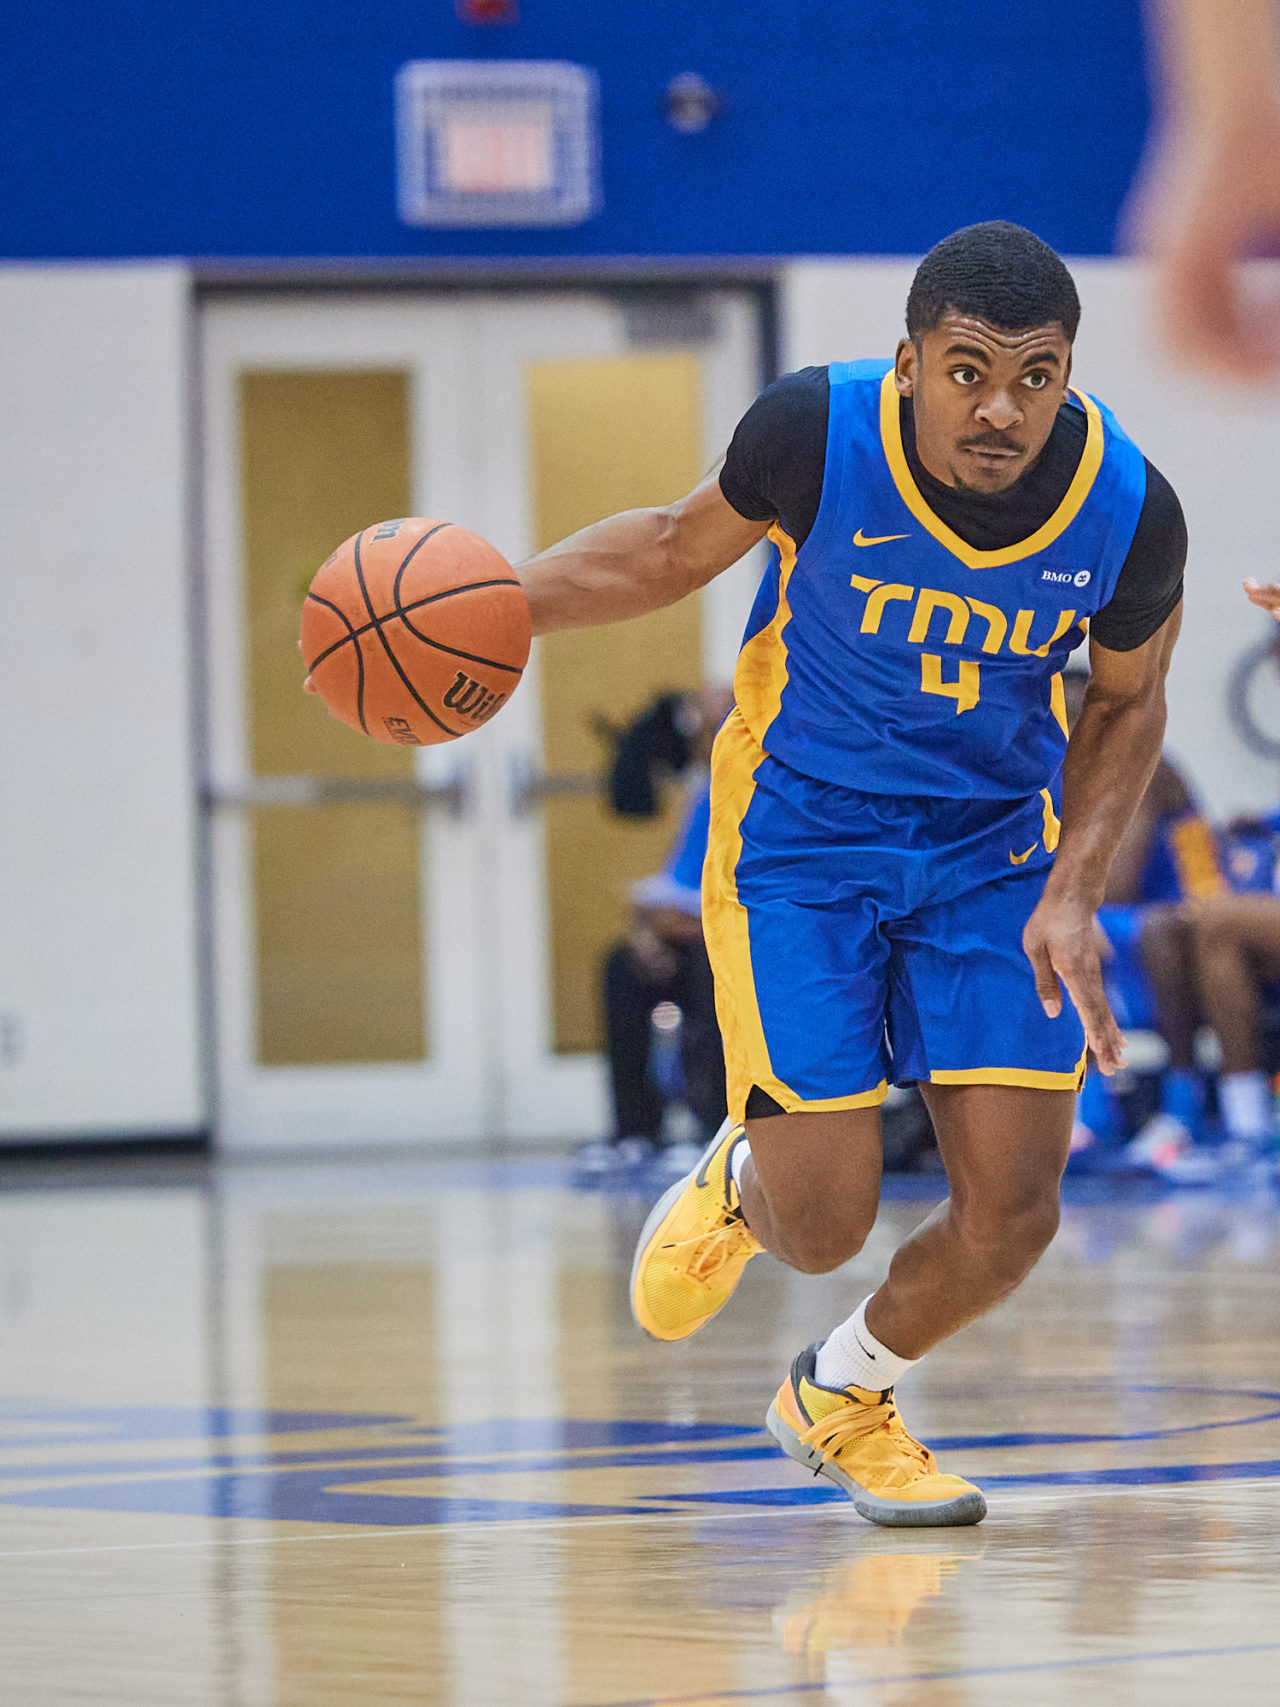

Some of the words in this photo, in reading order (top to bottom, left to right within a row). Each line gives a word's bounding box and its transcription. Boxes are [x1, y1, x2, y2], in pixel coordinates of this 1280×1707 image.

[1041, 569, 1073, 583] BMO
[850, 573, 1077, 659] TMU
[920, 652, 981, 715] 4
